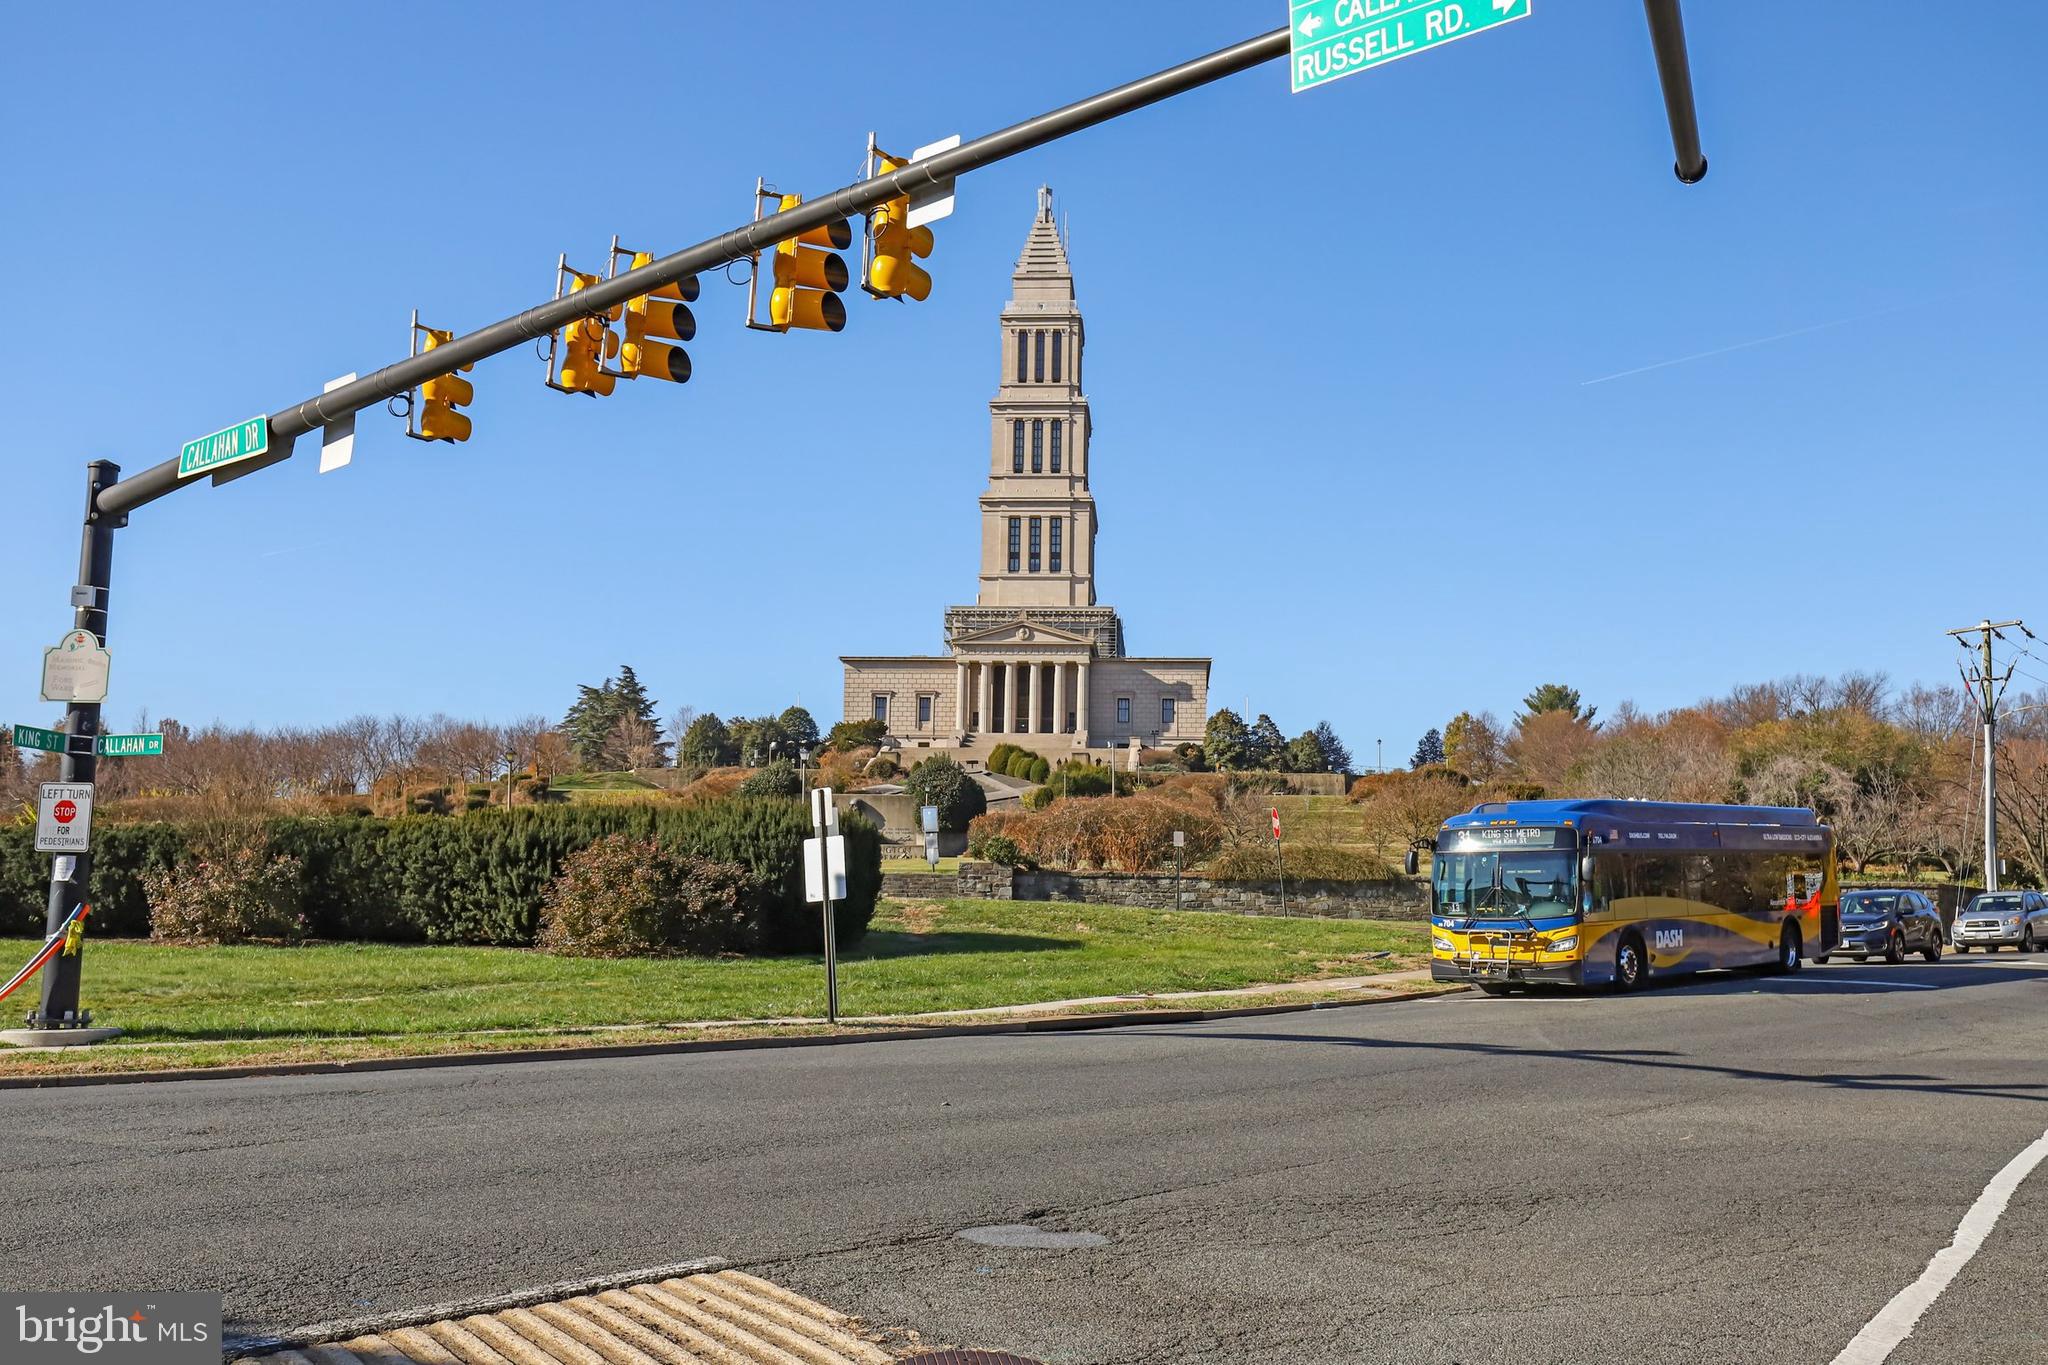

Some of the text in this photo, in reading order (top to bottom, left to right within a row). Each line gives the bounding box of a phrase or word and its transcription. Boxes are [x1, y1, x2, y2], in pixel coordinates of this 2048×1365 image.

[1298, 4, 1471, 83] RUSSELL RD.
[186, 422, 259, 470] CALLAHAN DR
[18, 729, 59, 750] KING ST
[98, 737, 159, 753] CALLAHAN DR
[42, 788, 91, 800] LEFT TURN
[54, 807, 76, 816] STOP
[57, 826, 70, 835] FOR
[1481, 829, 1501, 839] KING
[1503, 829, 1513, 838] ST
[1516, 828, 1541, 838] METRO
[40, 837, 85, 846] PEDESTRIANS
[1443, 919, 1455, 928] 704
[1655, 929, 1683, 949] DASH
